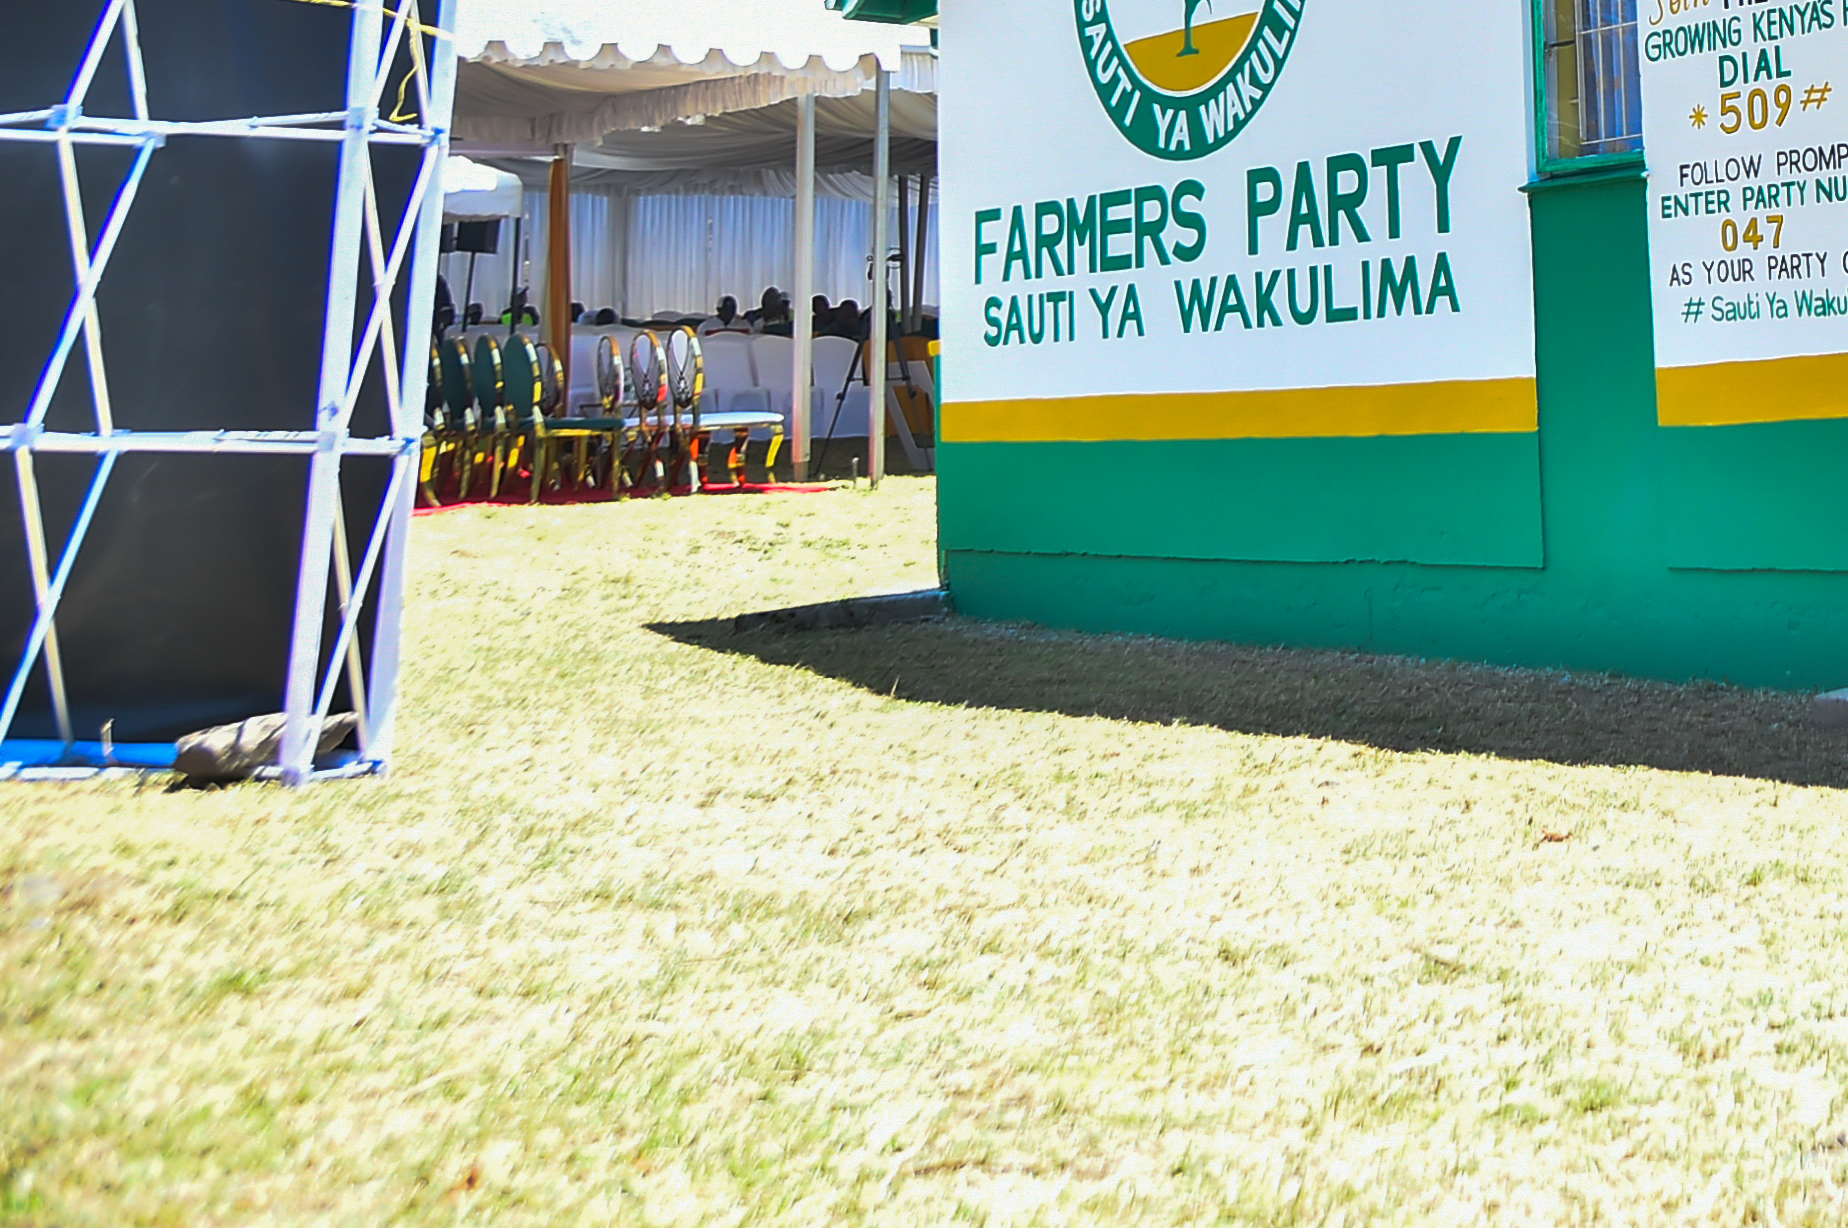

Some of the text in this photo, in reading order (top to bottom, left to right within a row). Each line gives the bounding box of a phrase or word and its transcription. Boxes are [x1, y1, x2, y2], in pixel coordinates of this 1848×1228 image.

[1645, 16, 1741, 62] GROWING
[1718, 45, 1791, 88] DIAL
[1152, 102, 1191, 152] YA
[1679, 154, 1762, 187] FOLLOW
[974, 135, 1462, 284] FARMERS PARTY
[1661, 188, 1731, 218] ENTER
[1742, 181, 1808, 212] PARTY
[1721, 215, 1784, 252] 047
[1669, 264, 1692, 287] AS
[1702, 258, 1755, 284] YOUR
[1768, 251, 1828, 280] PARTY
[984, 251, 1461, 347] SAUTI YA WAKULIMA
[1765, 292, 1789, 318] Ya
